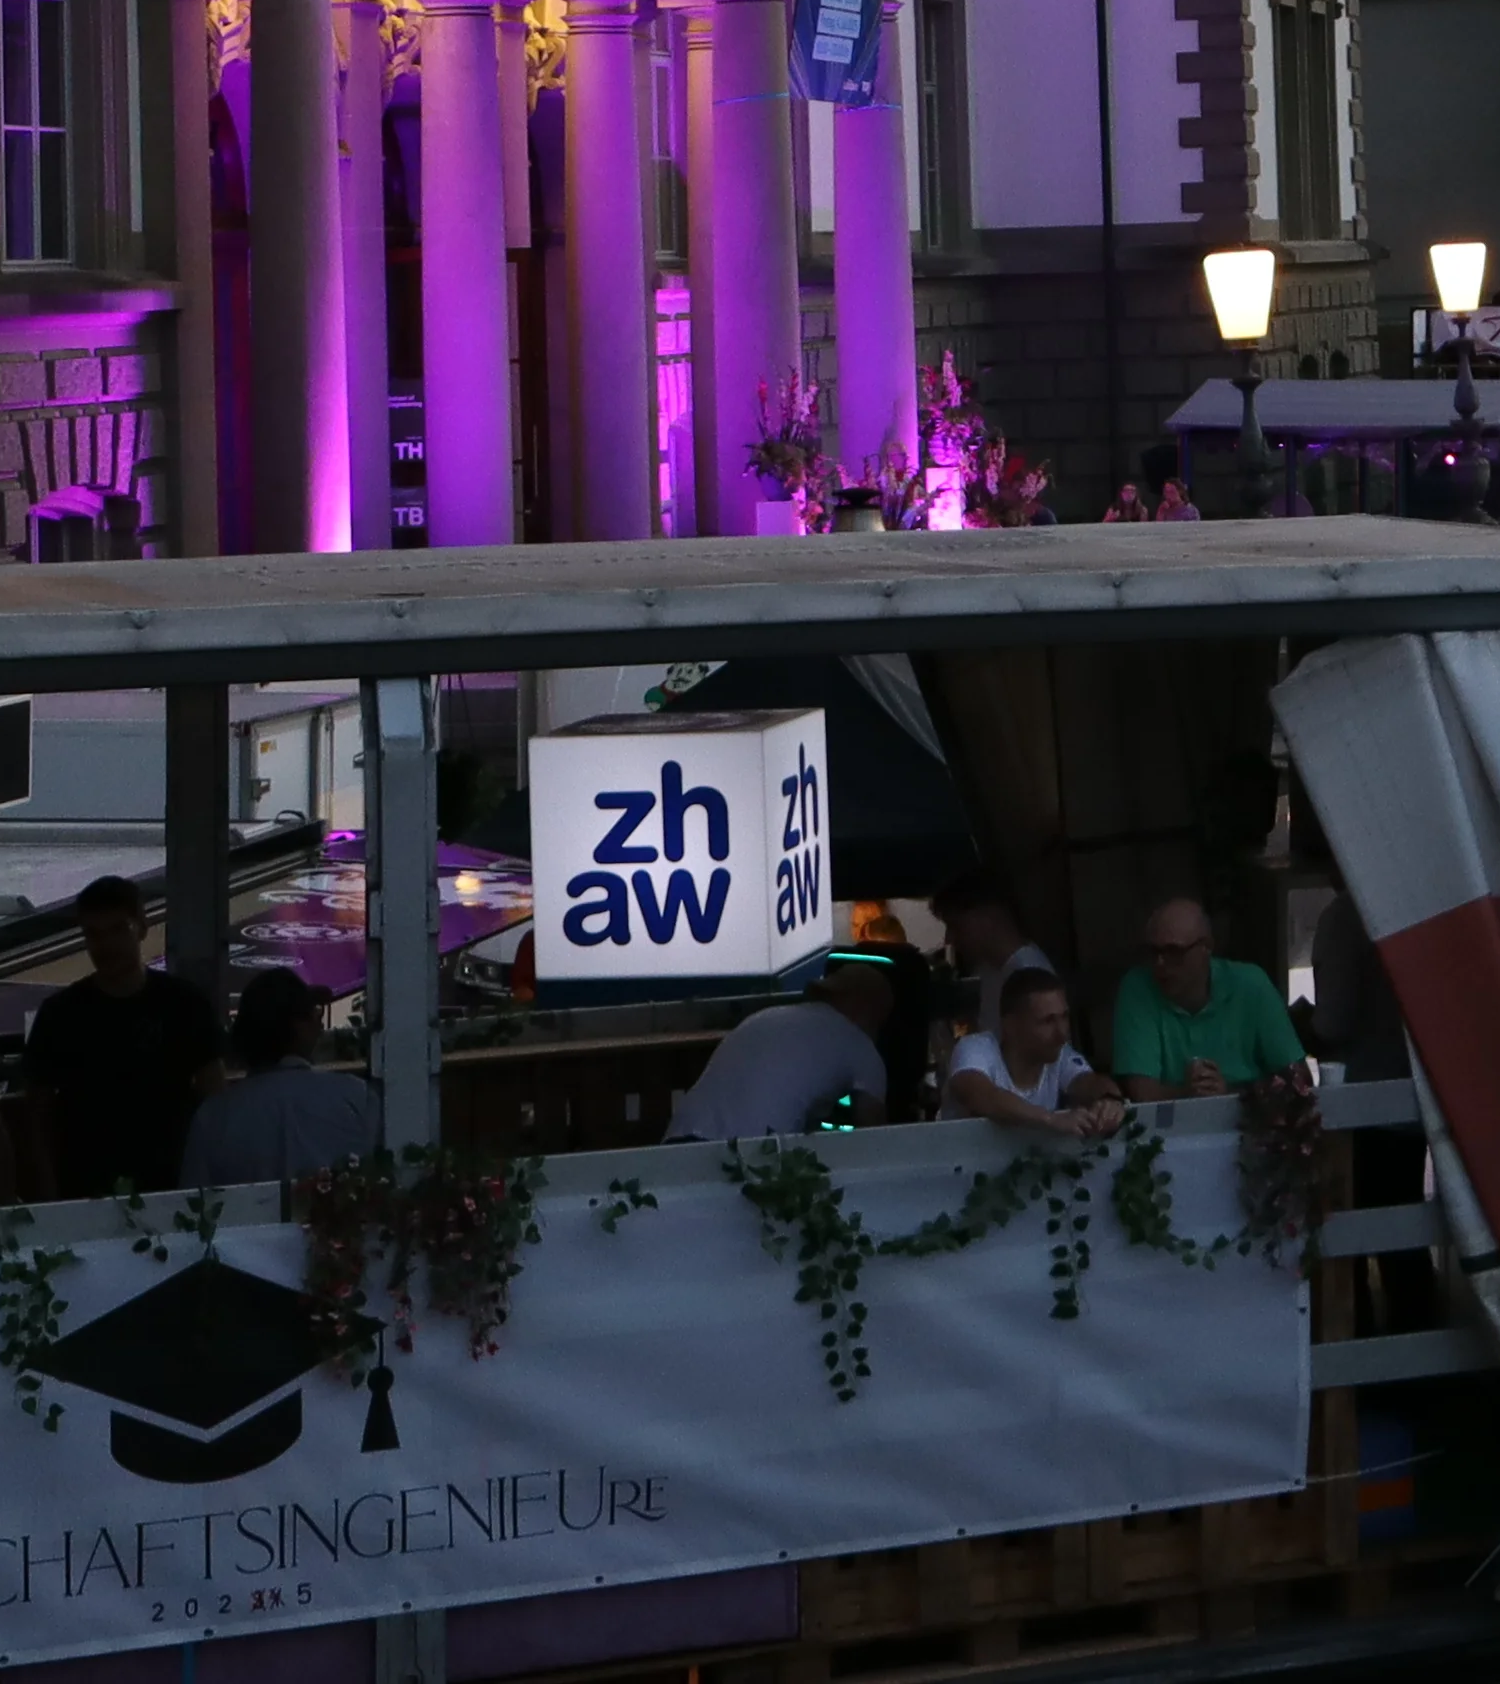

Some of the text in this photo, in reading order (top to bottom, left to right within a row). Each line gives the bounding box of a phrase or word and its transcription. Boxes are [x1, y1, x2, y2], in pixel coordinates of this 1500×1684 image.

[393, 441, 424, 461] TH
[393, 506, 425, 527] TB
[593, 760, 730, 864] zh
[781, 741, 819, 852] zh
[562, 867, 731, 947] aw
[776, 843, 820, 936] aw
